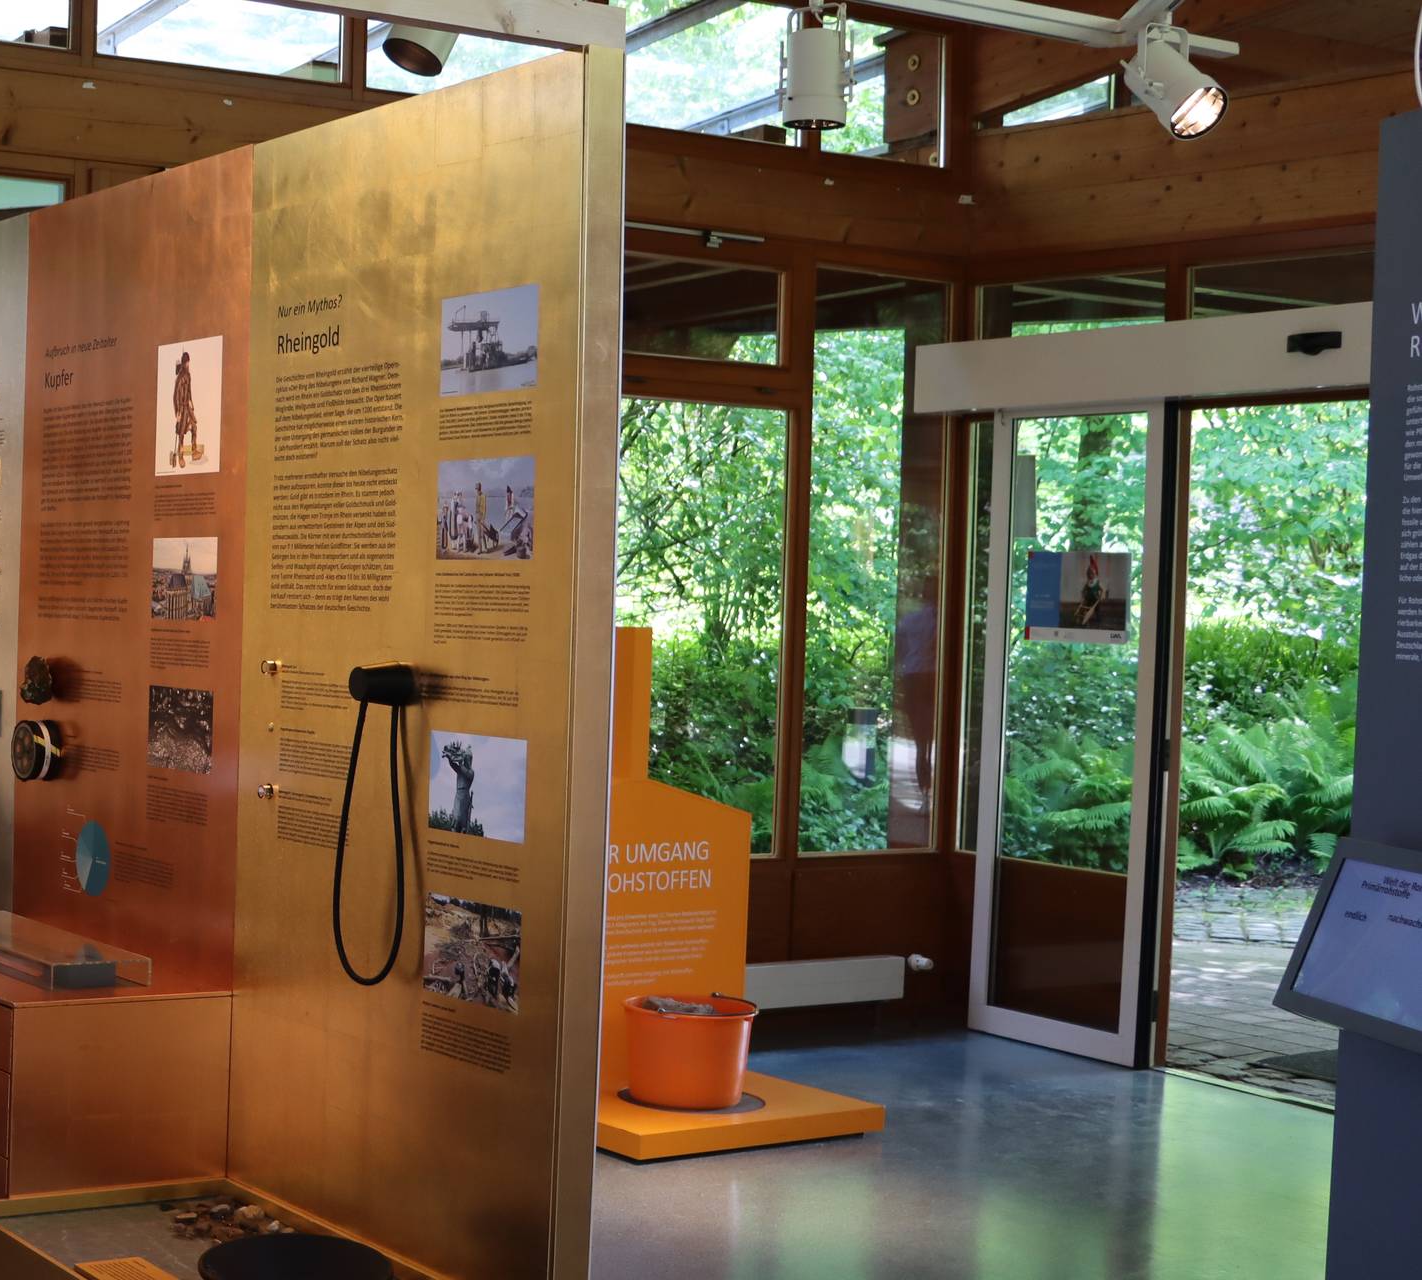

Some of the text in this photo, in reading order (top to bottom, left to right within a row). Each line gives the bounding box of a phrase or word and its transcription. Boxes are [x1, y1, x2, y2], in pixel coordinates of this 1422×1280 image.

[278, 294, 342, 318] Nur ein Mythos?
[278, 325, 339, 354] Rheingold
[45, 369, 73, 390] Kupfer
[626, 841, 709, 864] UMGANG
[609, 869, 711, 893] OHSTOFFEN
